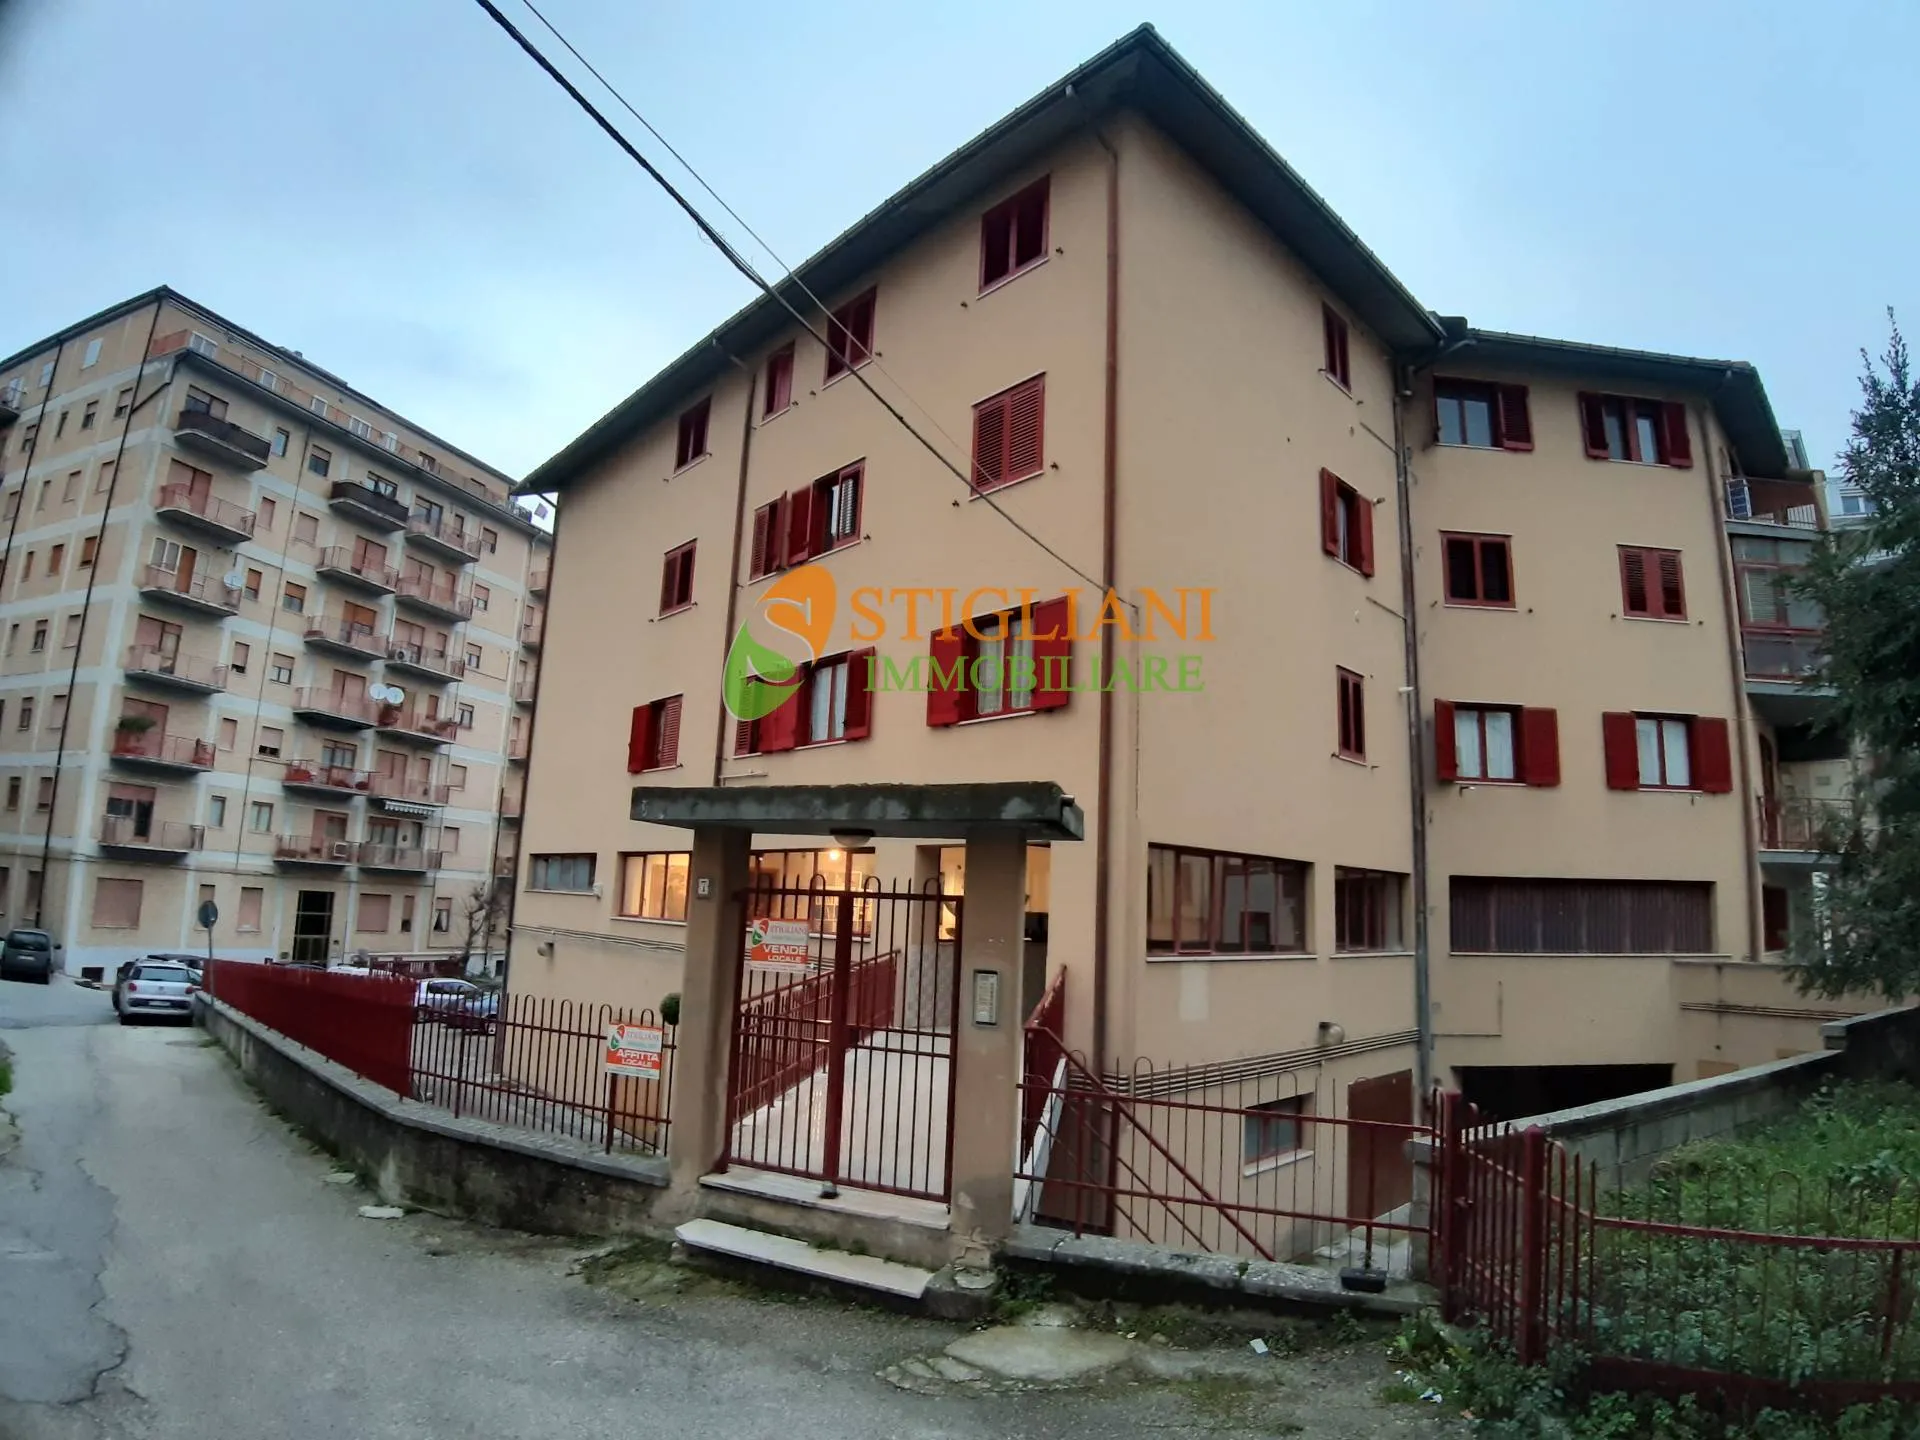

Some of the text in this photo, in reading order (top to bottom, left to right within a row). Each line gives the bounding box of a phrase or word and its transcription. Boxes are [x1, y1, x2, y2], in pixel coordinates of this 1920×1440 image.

[763, 945, 807, 955] VENDE
[616, 1049, 659, 1061] AFFITTA
[622, 1059, 652, 1067] LOCALE
